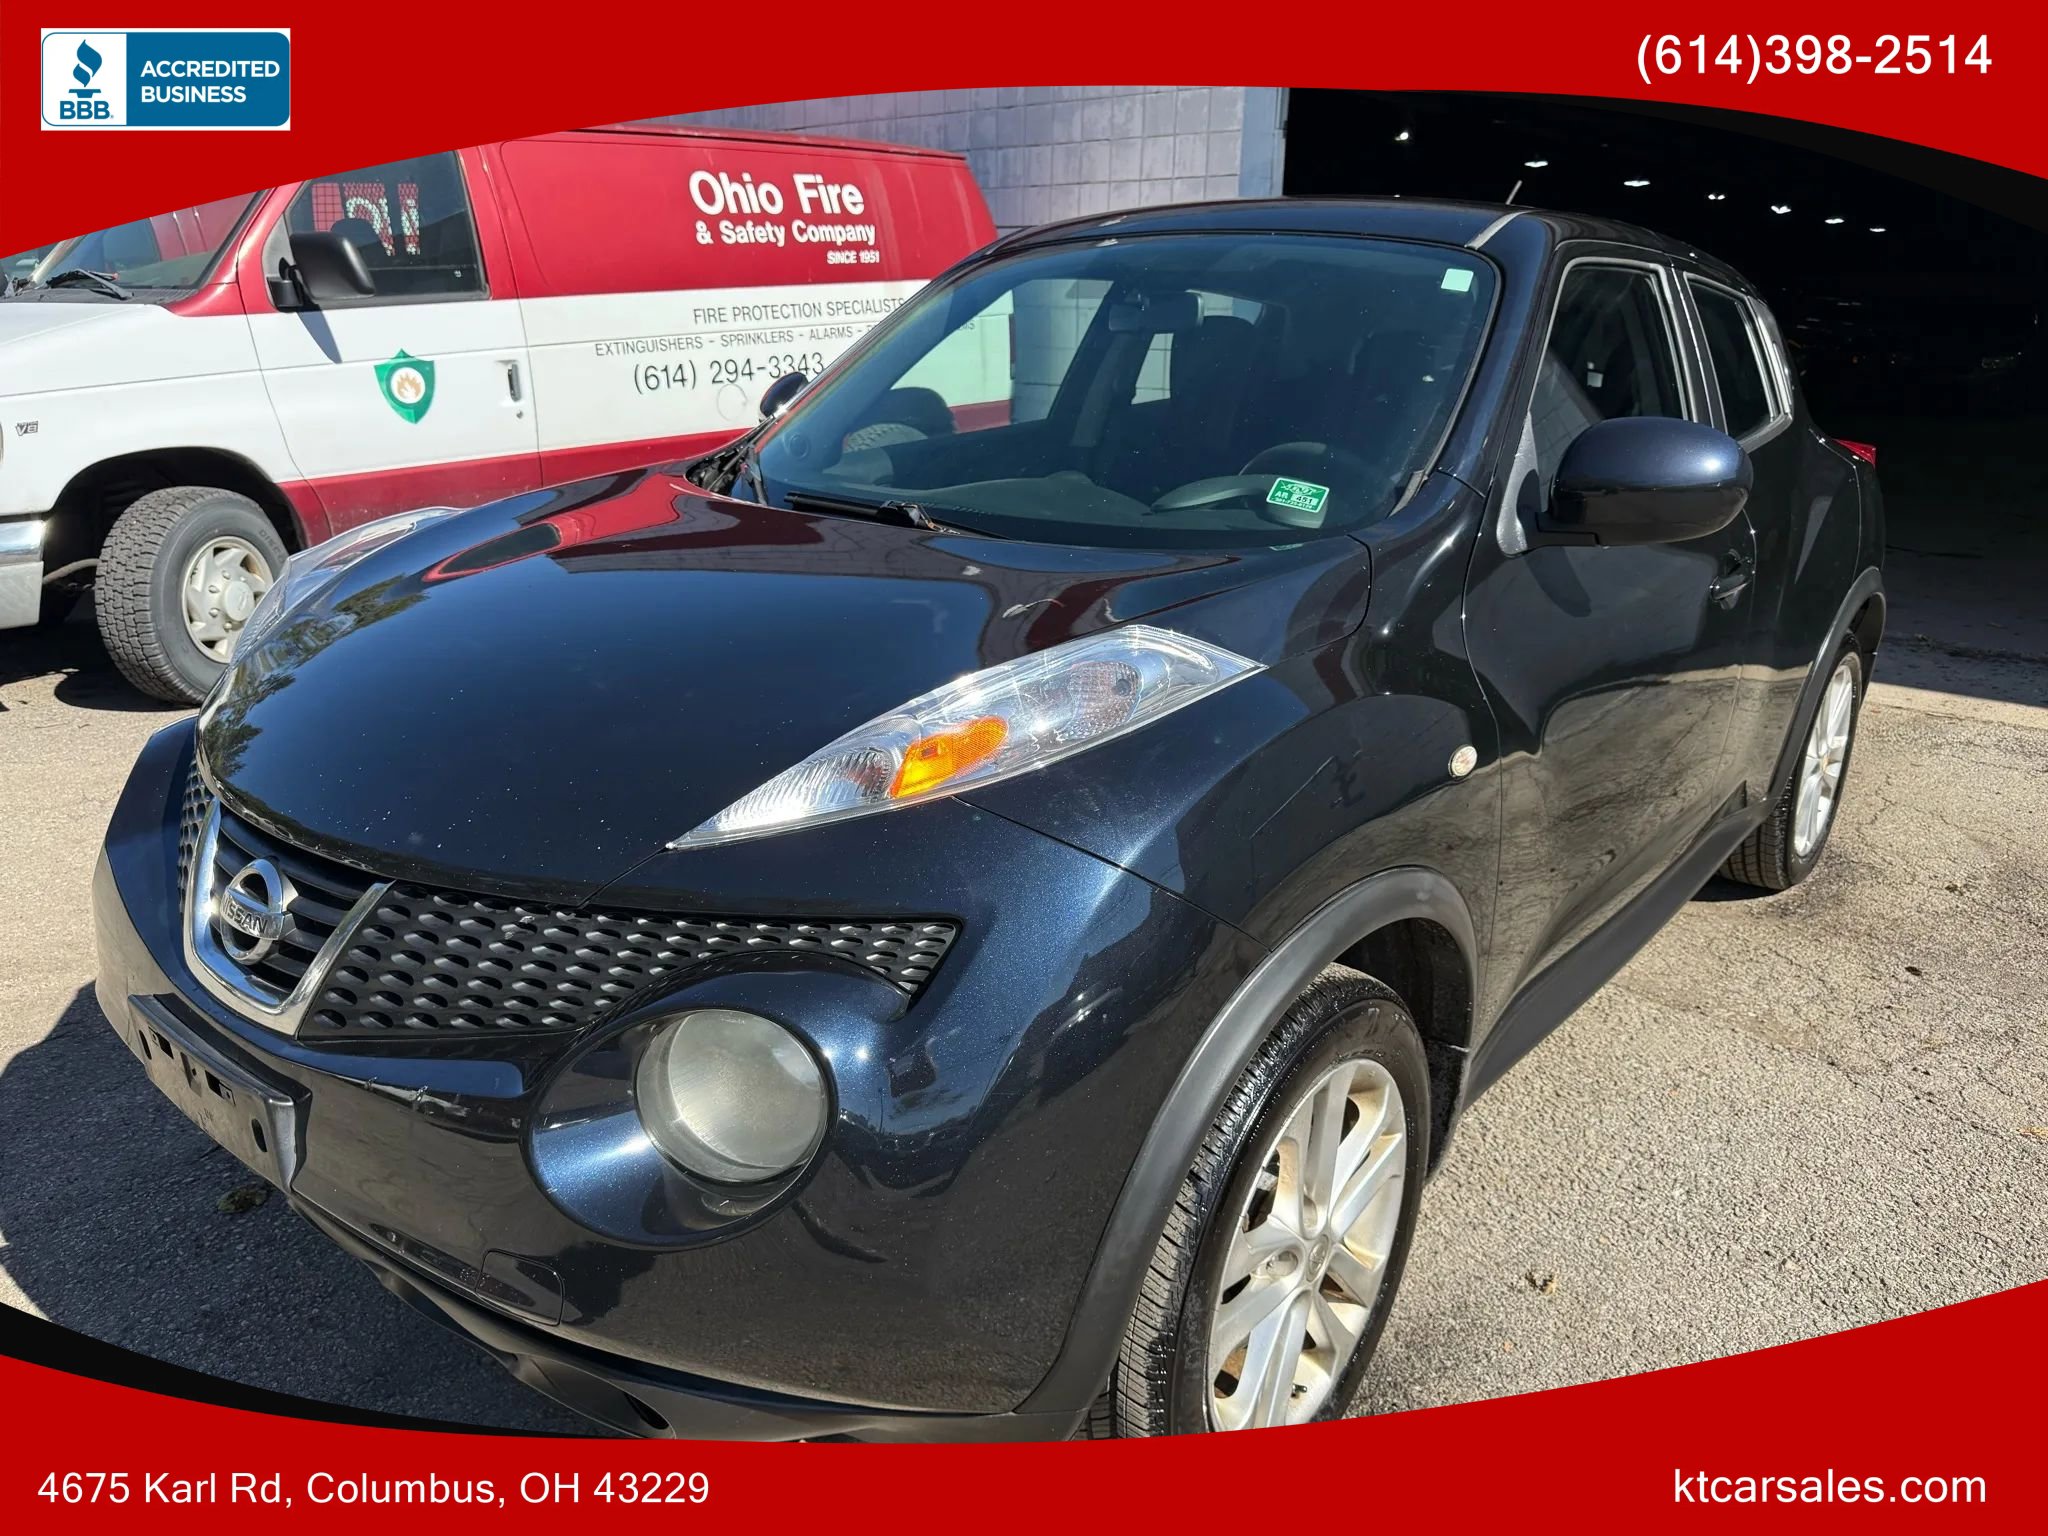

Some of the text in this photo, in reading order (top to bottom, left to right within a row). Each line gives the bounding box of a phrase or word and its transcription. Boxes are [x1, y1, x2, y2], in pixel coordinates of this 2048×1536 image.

[689, 170, 865, 215] Ohio Fire
[695, 219, 876, 247] & Safety Company
[826, 250, 880, 264] SINCE 1951
[693, 307, 728, 324] FIRE
[732, 302, 822, 322] PROTECTION
[595, 336, 704, 356] EXTINGUISHERS
[720, 330, 794, 348] SPRINKLERS
[809, 325, 853, 340] ALARMS
[634, 352, 825, 394] (614) 294-3343
[1274, 490, 1289, 500] AR
[1296, 496, 1313, 504] 451
[222, 893, 268, 934] NISSAN
